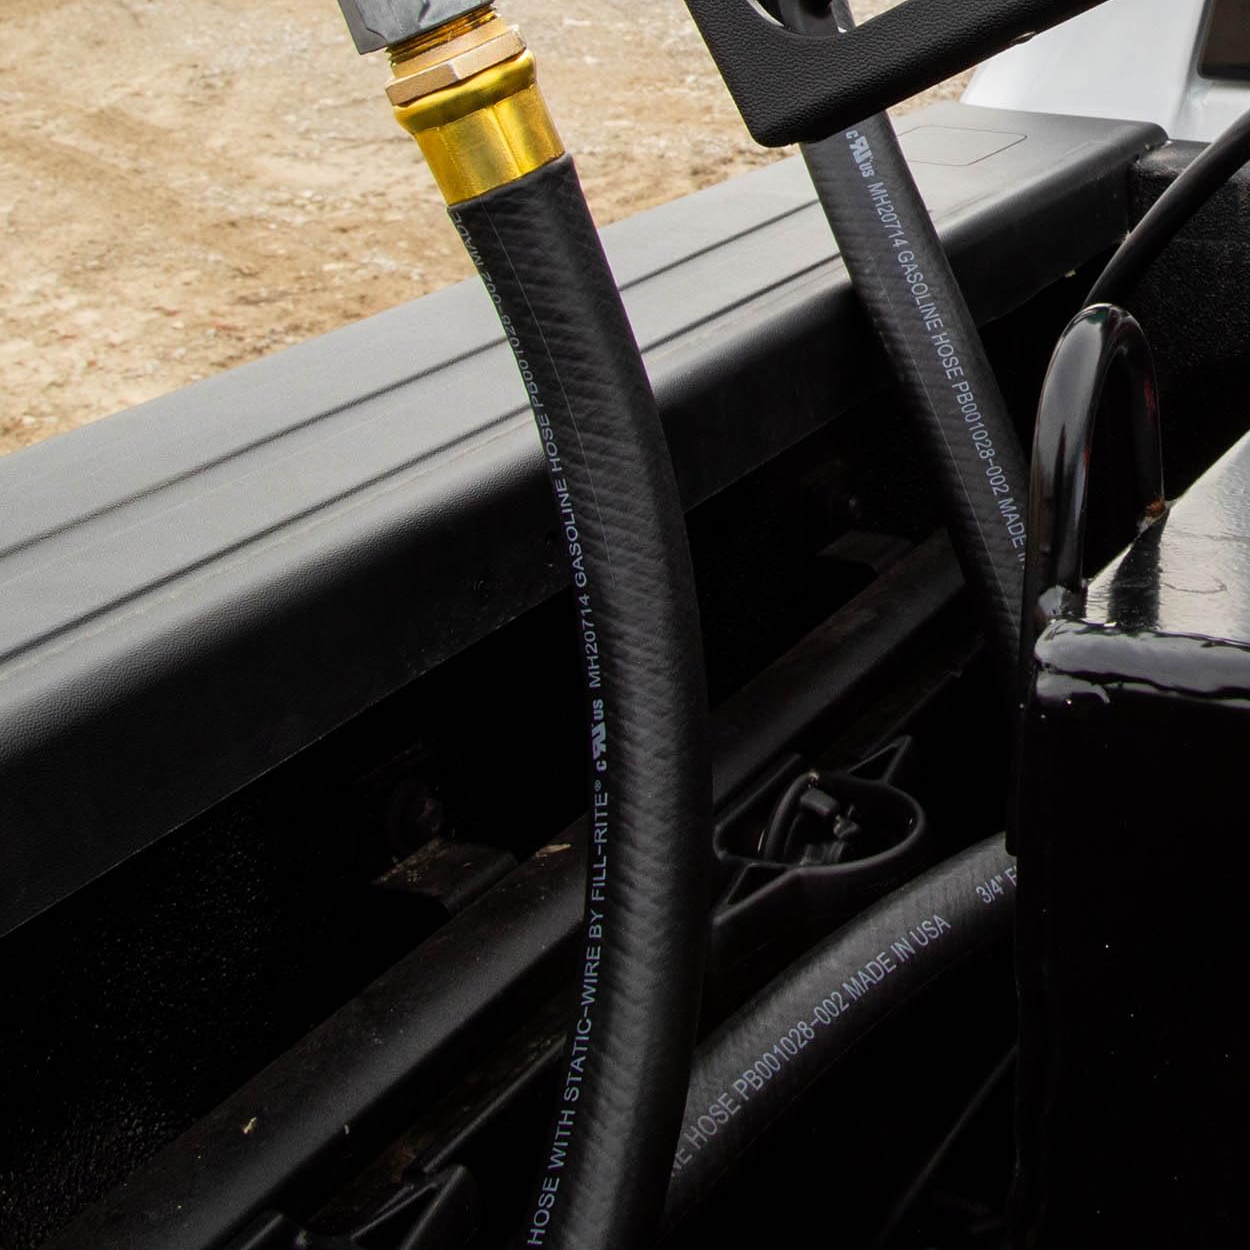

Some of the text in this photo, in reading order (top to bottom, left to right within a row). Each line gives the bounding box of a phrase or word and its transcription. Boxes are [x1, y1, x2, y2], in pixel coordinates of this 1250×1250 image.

[867, 181, 907, 248] MH20714
[897, 251, 944, 331] GASOLINE
[931, 331, 965, 380] HOSE
[952, 381, 1010, 496] PB001028-002
[998, 497, 1027, 549] MADE
[539, 413, 563, 472] HOSE
[555, 477, 588, 588] GASOLINE
[578, 594, 602, 689] MH20714
[589, 909, 604, 939] BY
[564, 945, 602, 1102] STATIC-WIRE
[683, 1092, 741, 1149] HOSE
[732, 991, 850, 1101] PB001028-002
[842, 952, 897, 1001] MADE
[890, 937, 916, 963] IN
[909, 914, 952, 947] USA
[547, 1109, 576, 1169] WITH
[527, 1176, 560, 1245] HOSE
